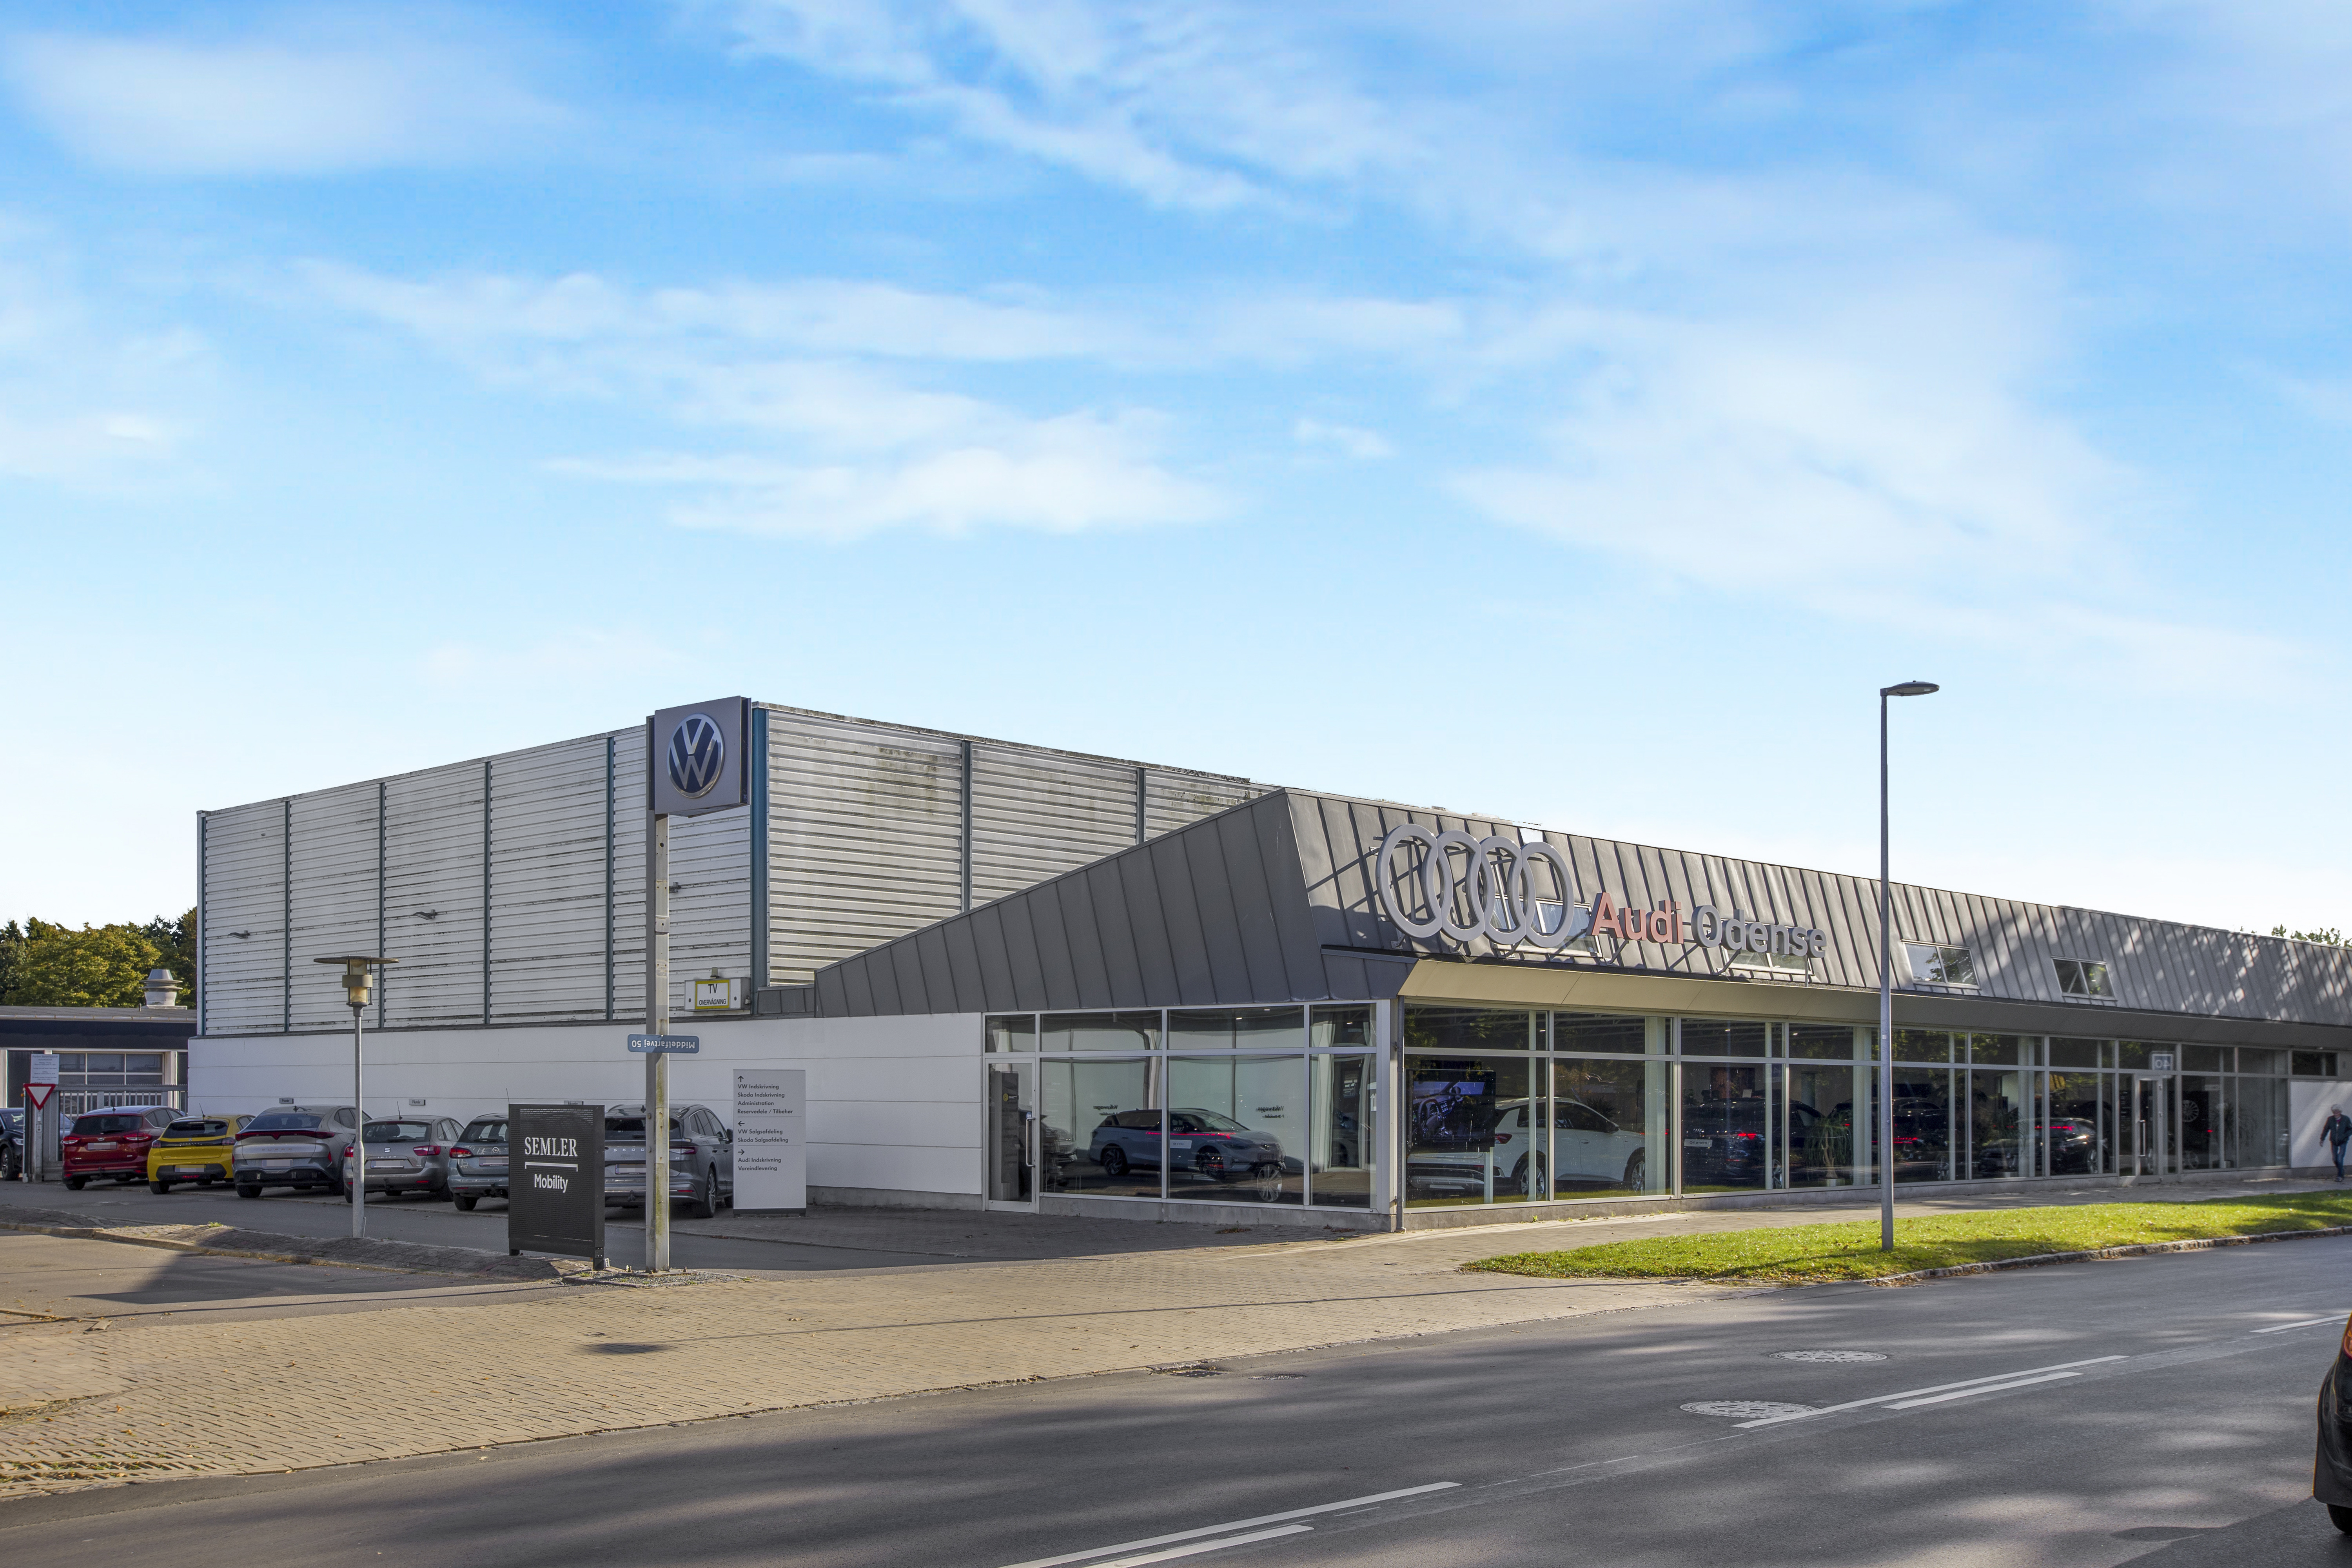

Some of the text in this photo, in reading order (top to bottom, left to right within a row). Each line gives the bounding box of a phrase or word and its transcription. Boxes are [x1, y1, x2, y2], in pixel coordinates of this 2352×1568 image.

[1587, 892, 1827, 958] Audi Odense
[708, 983, 718, 994] TV
[644, 1039, 695, 1049] Middelfartvej
[525, 1137, 578, 1157] SEMLER
[534, 1174, 568, 1193] Mobility
